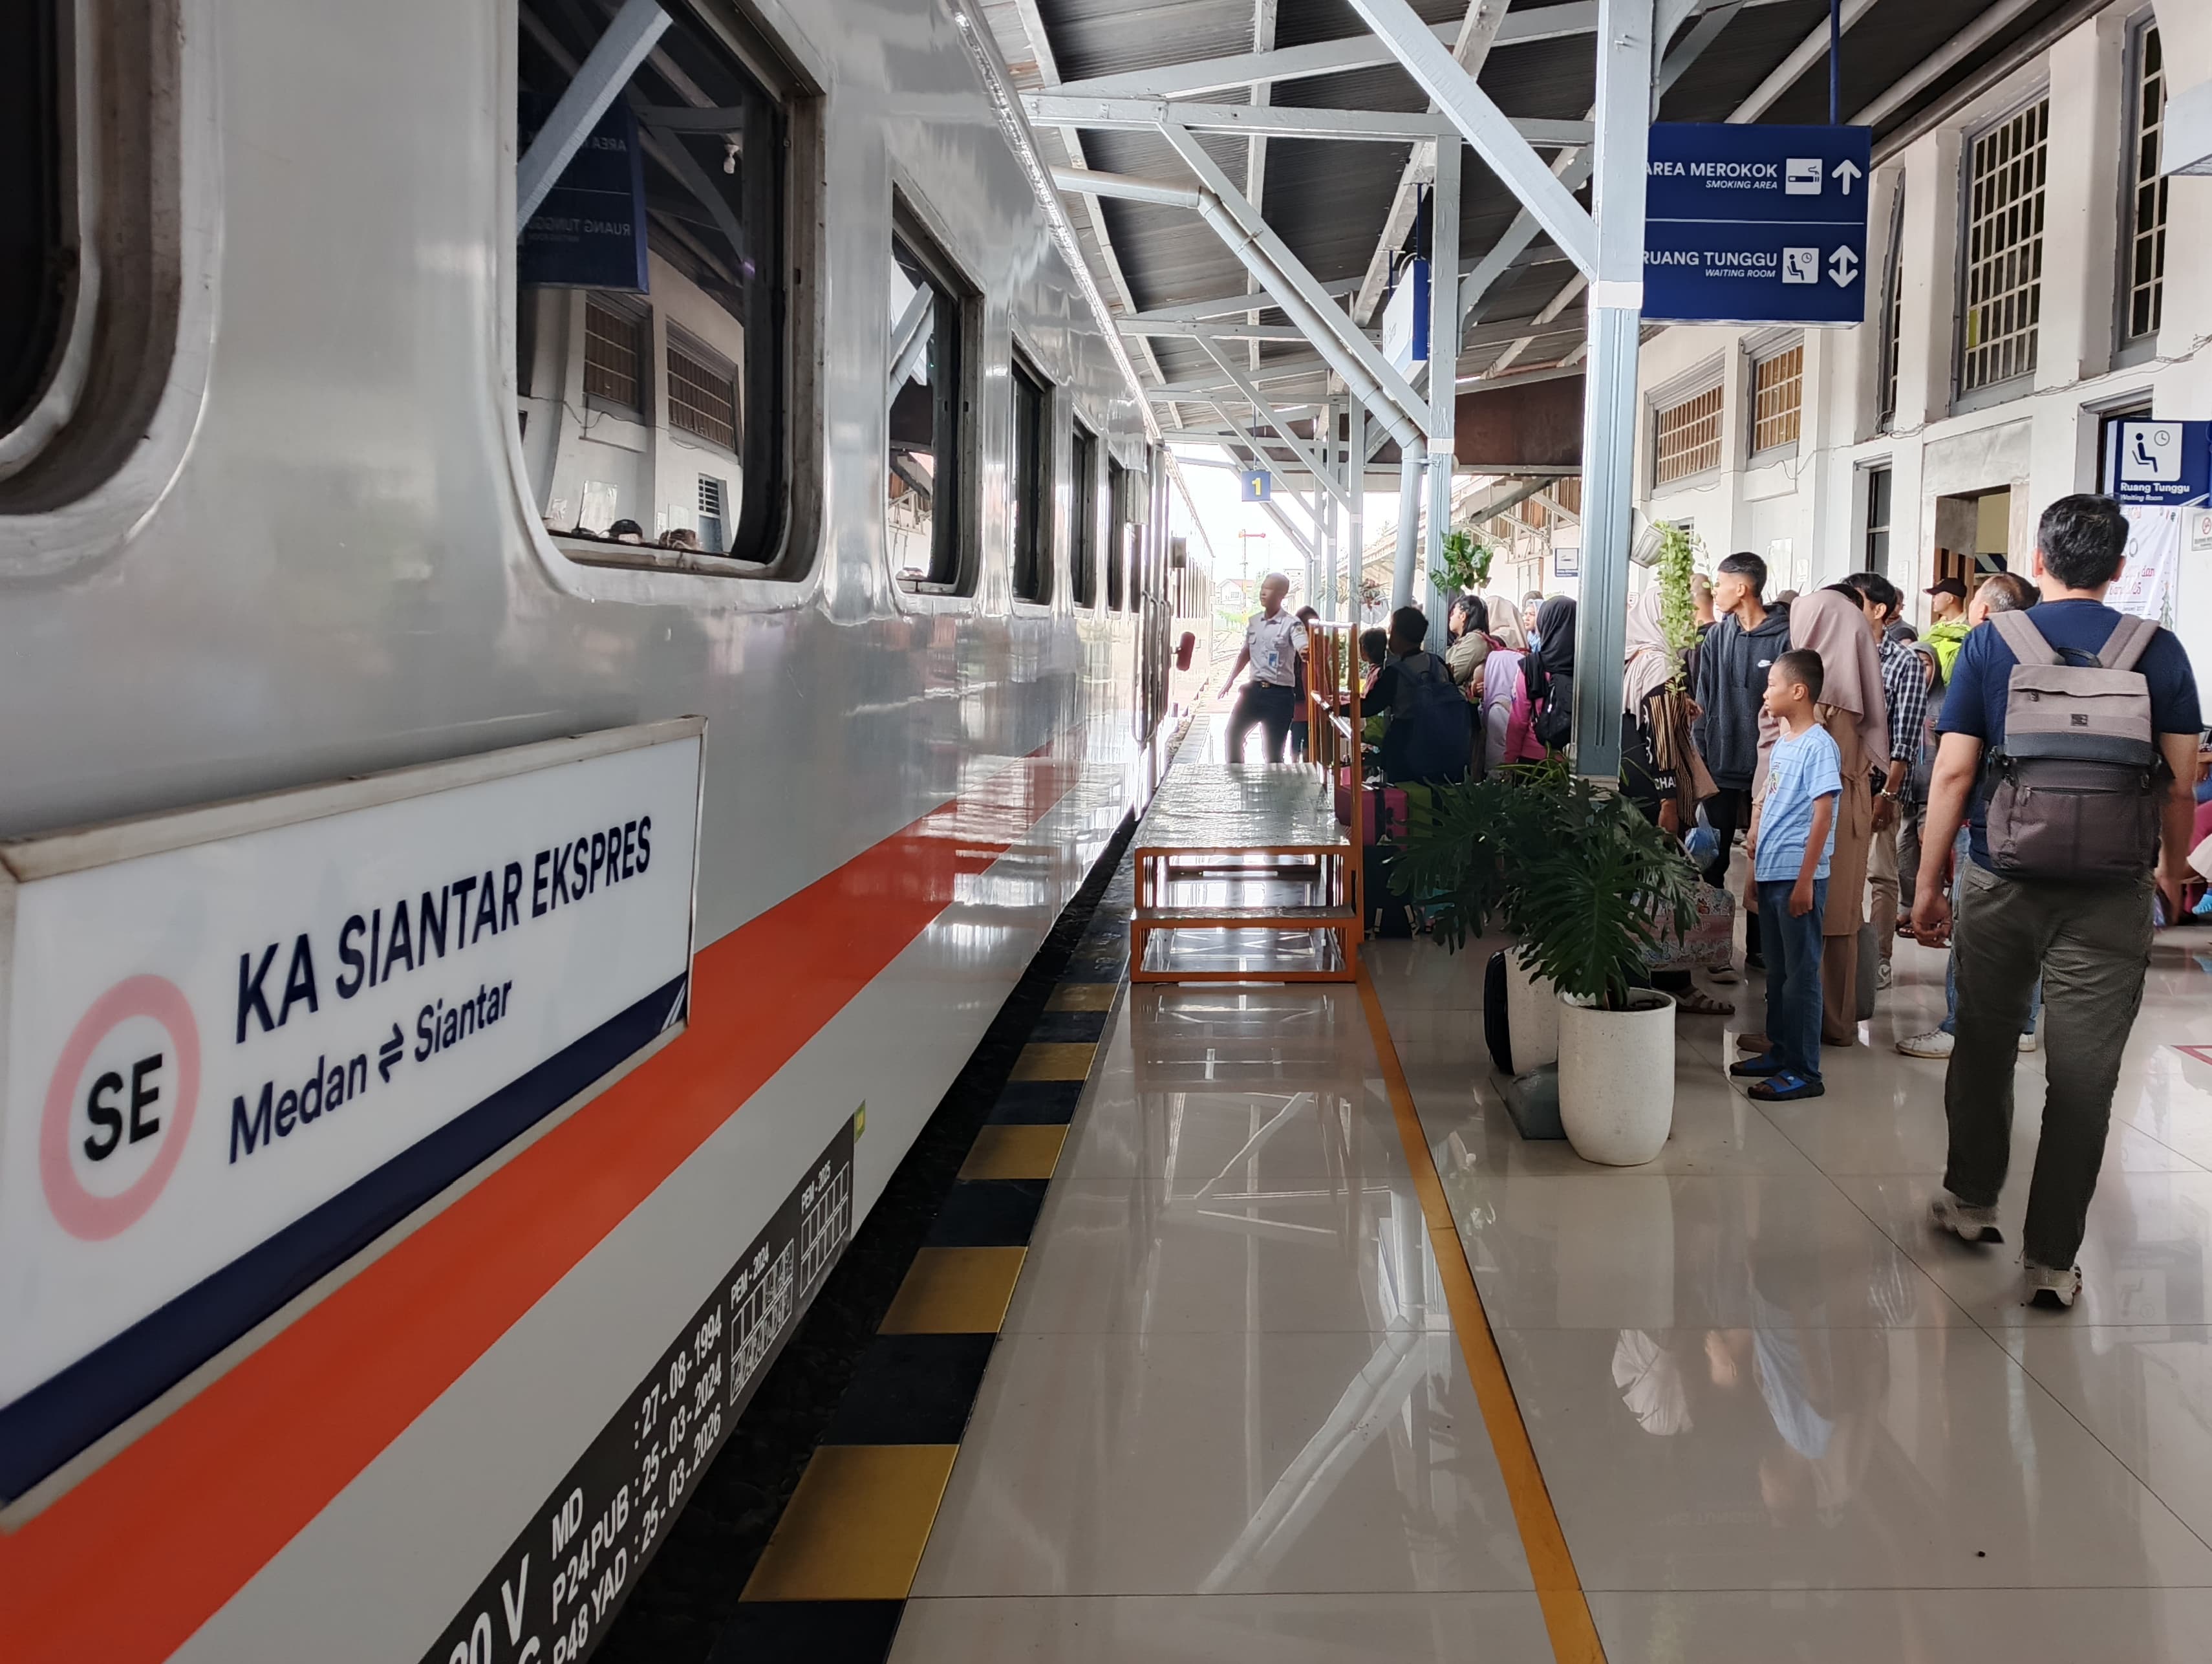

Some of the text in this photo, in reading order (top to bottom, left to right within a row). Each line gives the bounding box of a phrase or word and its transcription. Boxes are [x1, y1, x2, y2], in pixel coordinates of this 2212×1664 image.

[1690, 162, 1777, 177] MEROKOK
[1706, 180, 1777, 189] SMOKING AREA
[1704, 252, 1777, 266] TUNGGU
[1706, 269, 1745, 277] WAITING
[1252, 477, 1261, 495] 1
[2121, 482, 2190, 494] Ruang Tunggu
[1655, 776, 1676, 790] CHA
[235, 815, 652, 1043] KA SIANTAR EKSPRES
[229, 980, 513, 1164] Medan Siantar
[83, 1054, 163, 1162] SE
[552, 1487, 583, 1562] MD
[591, 1546, 627, 1625] YAD
[501, 1552, 530, 1647] V
